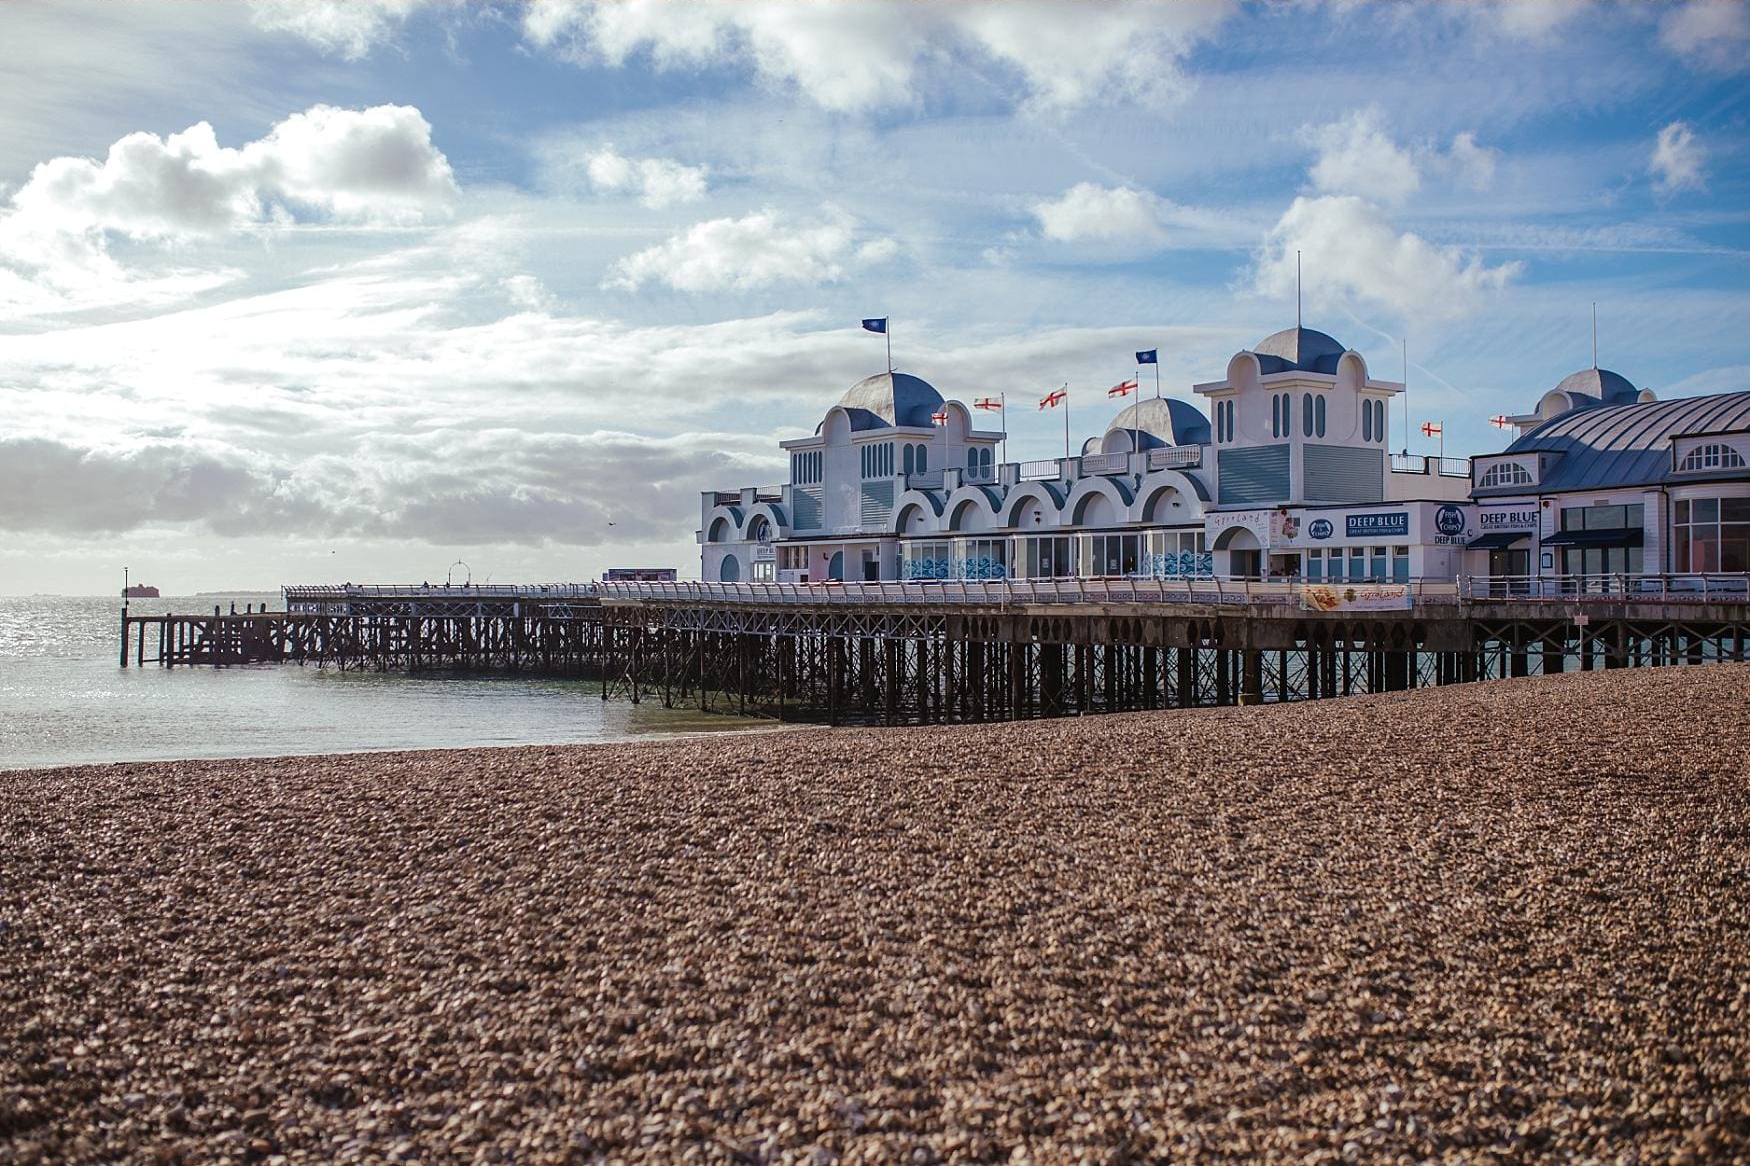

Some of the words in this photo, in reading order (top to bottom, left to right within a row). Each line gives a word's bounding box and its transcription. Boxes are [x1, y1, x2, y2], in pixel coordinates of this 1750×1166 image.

[1349, 516, 1375, 527] DEEP
[1377, 515, 1405, 526] BLUE
[1480, 513, 1507, 524] DEEP
[1509, 511, 1537, 522] BLUE
[1435, 536, 1450, 544] DEEP
[1451, 536, 1465, 544] BLUE
